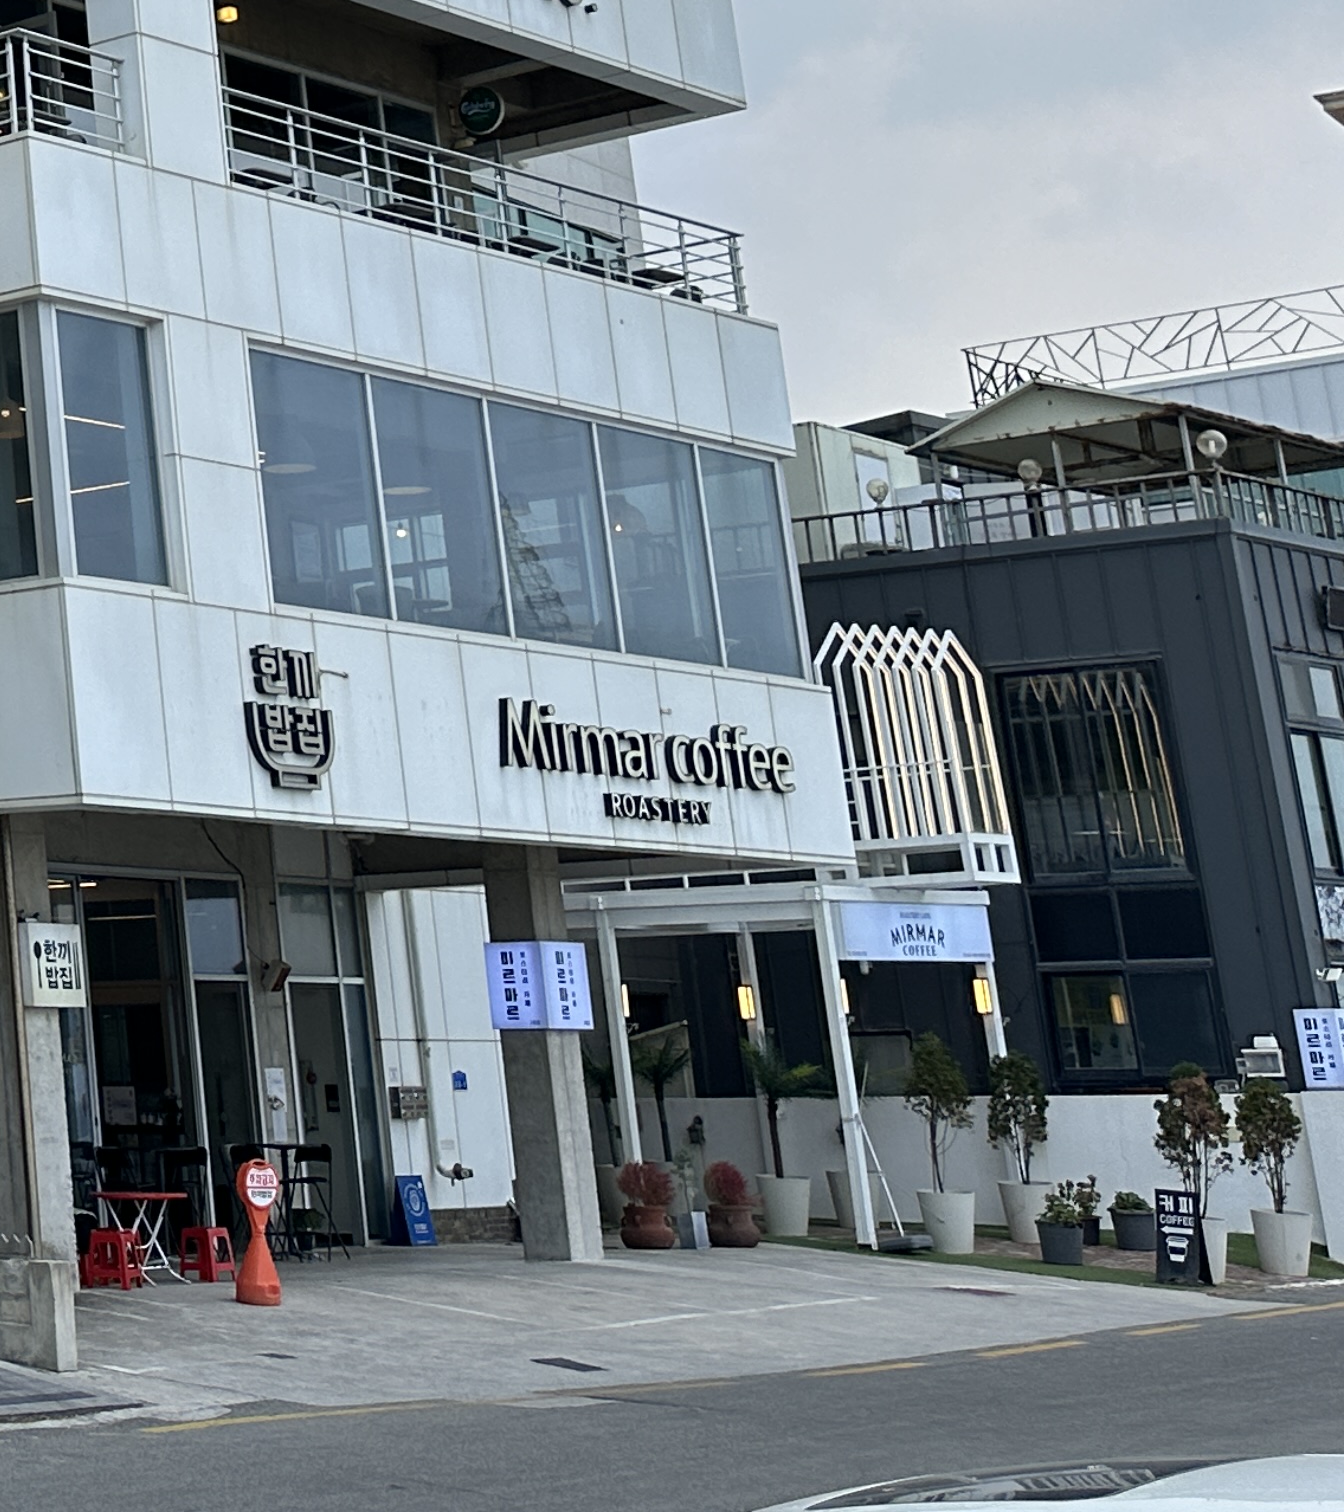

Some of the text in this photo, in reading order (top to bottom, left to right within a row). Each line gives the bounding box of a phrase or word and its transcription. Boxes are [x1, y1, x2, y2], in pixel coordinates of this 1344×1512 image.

[249, 644, 319, 698] 한끼
[256, 703, 326, 756] 밥집
[499, 696, 797, 793] Mirmar coffee
[603, 793, 713, 825] ROASTERY
[43, 939, 72, 964] 한끼
[890, 923, 946, 948] MIRMAR
[902, 944, 938, 957] COFFEE
[44, 966, 74, 990] 밥집
[499, 950, 520, 1021] 미르마르
[554, 950, 571, 1020] 미르마르
[1303, 1017, 1328, 1081] 미르마르
[1158, 1194, 1194, 1215] 커피
[1159, 1213, 1195, 1227] COFFEE
